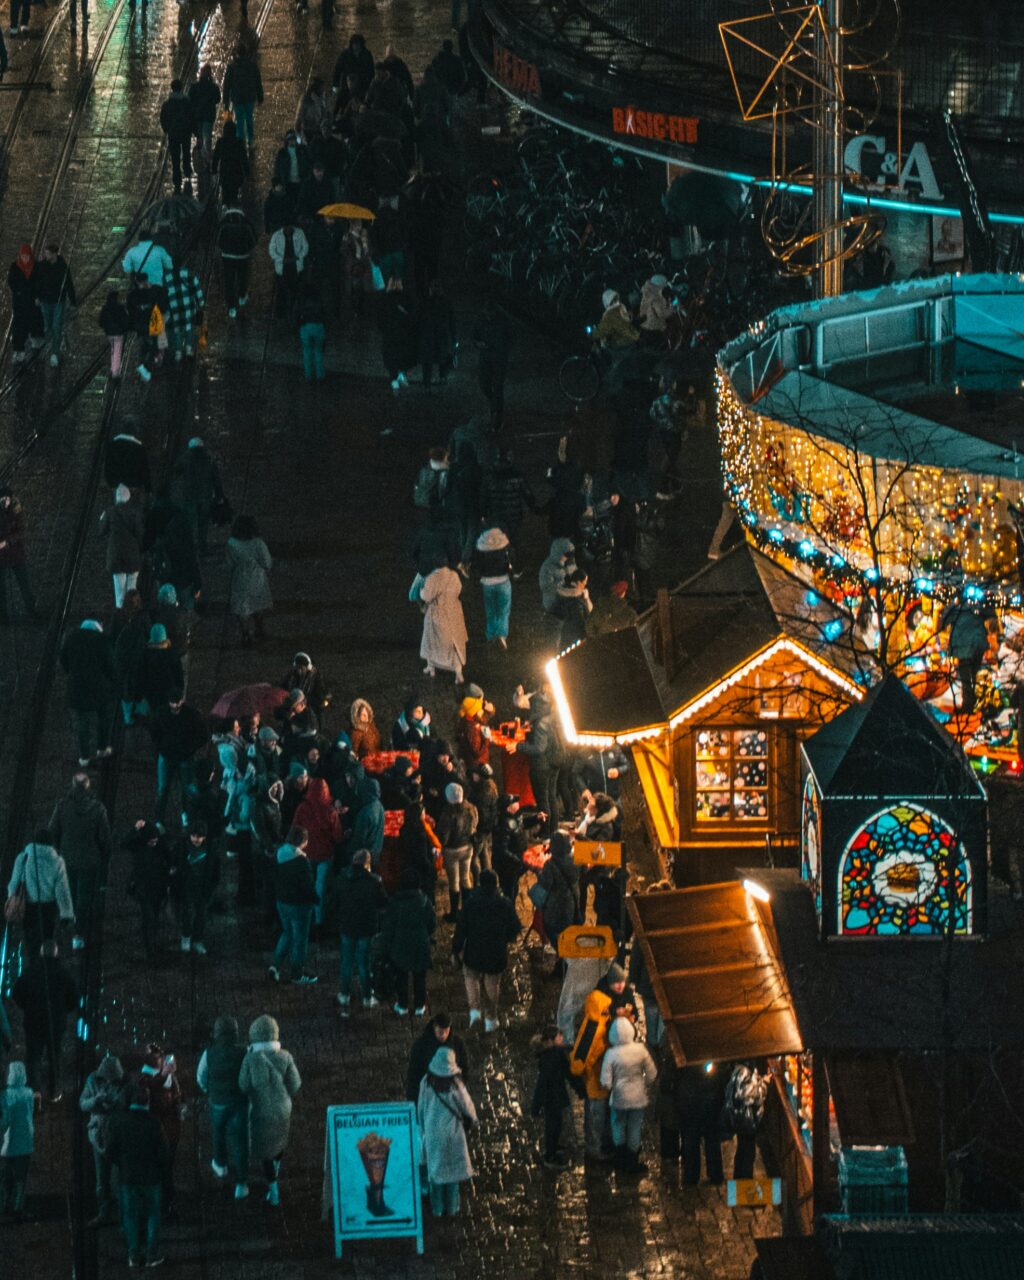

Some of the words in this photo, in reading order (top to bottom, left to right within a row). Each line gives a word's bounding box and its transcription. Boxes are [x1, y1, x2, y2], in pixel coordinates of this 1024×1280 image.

[844, 134, 945, 201] C&A
[336, 1117, 379, 1129] BELGIAN
[382, 1115, 409, 1127] FRIES
